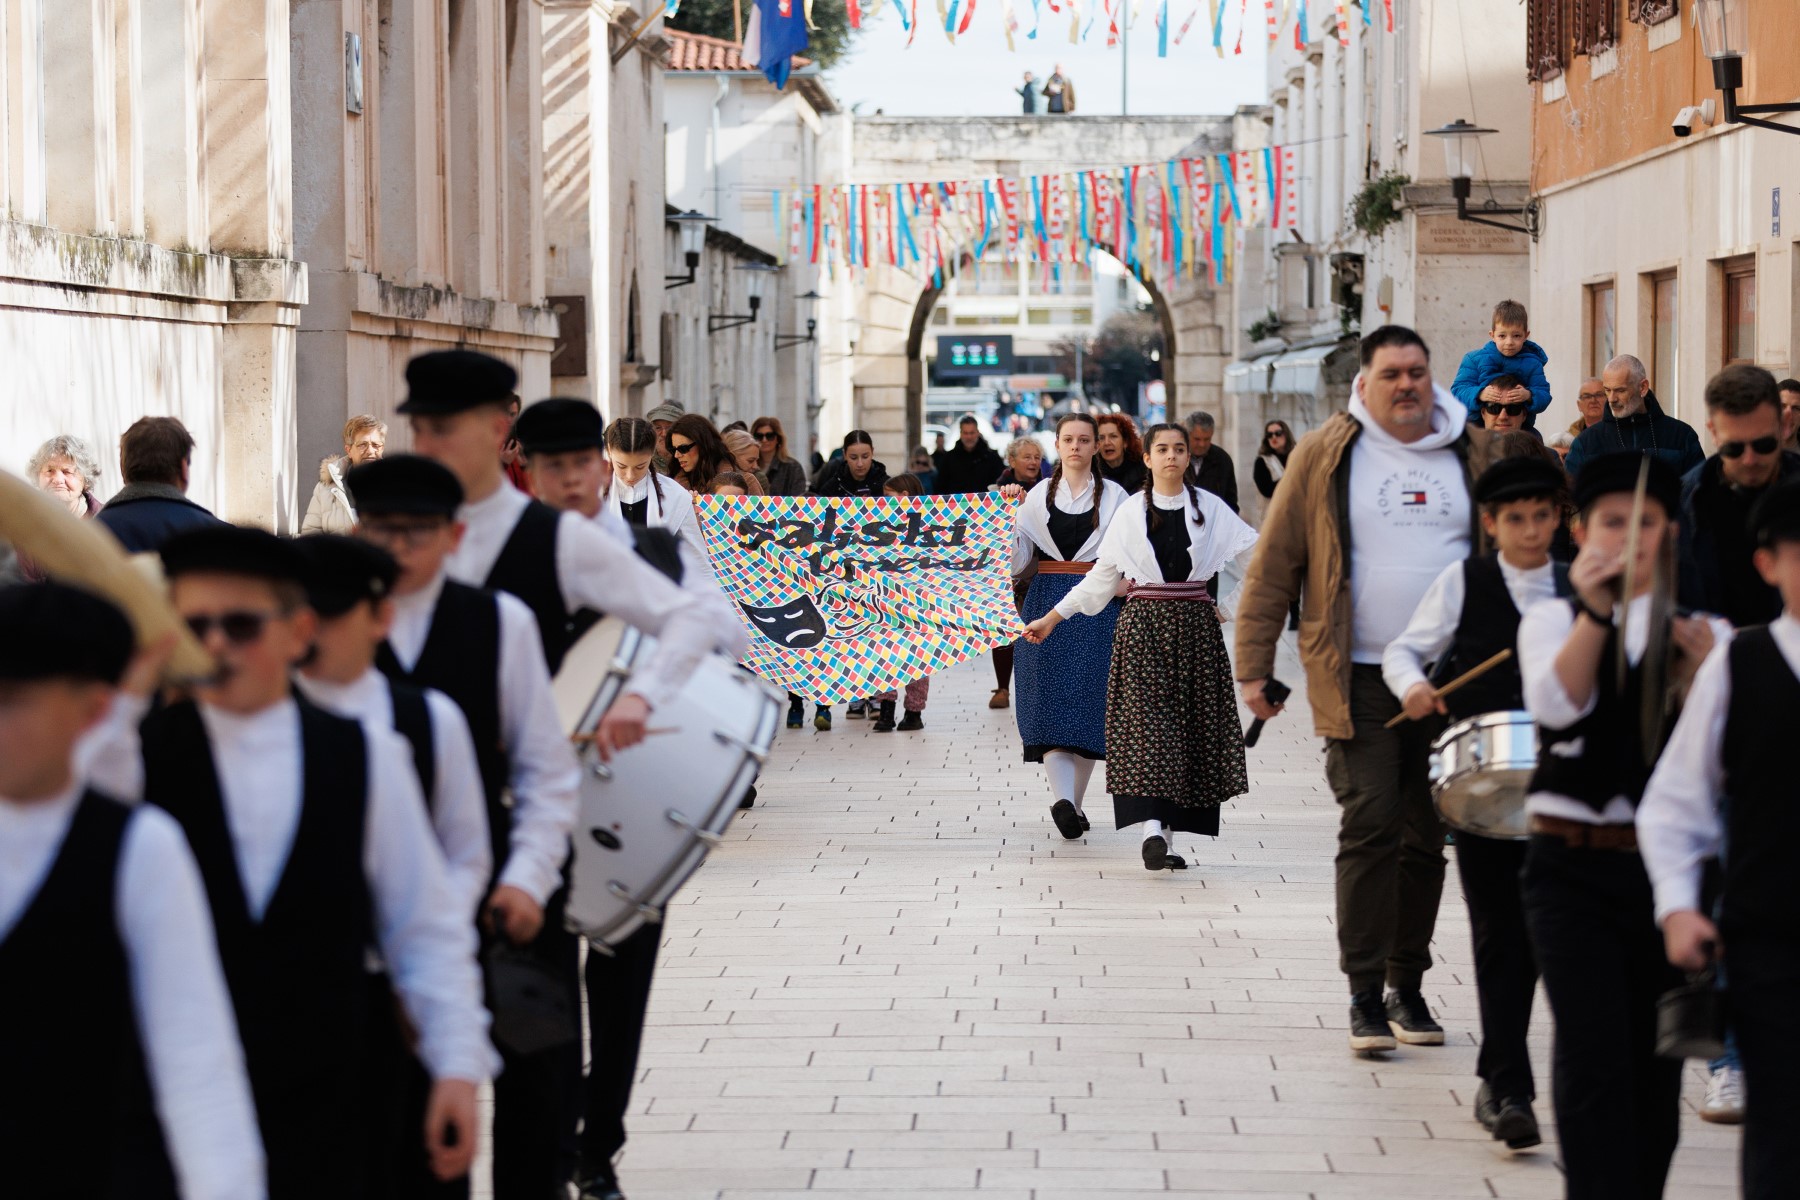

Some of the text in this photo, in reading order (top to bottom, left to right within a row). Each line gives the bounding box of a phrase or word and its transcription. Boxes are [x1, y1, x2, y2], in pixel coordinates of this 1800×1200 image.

[1377, 469, 1452, 517] TOMMY HILFIGER
[737, 506, 969, 556] saljski
